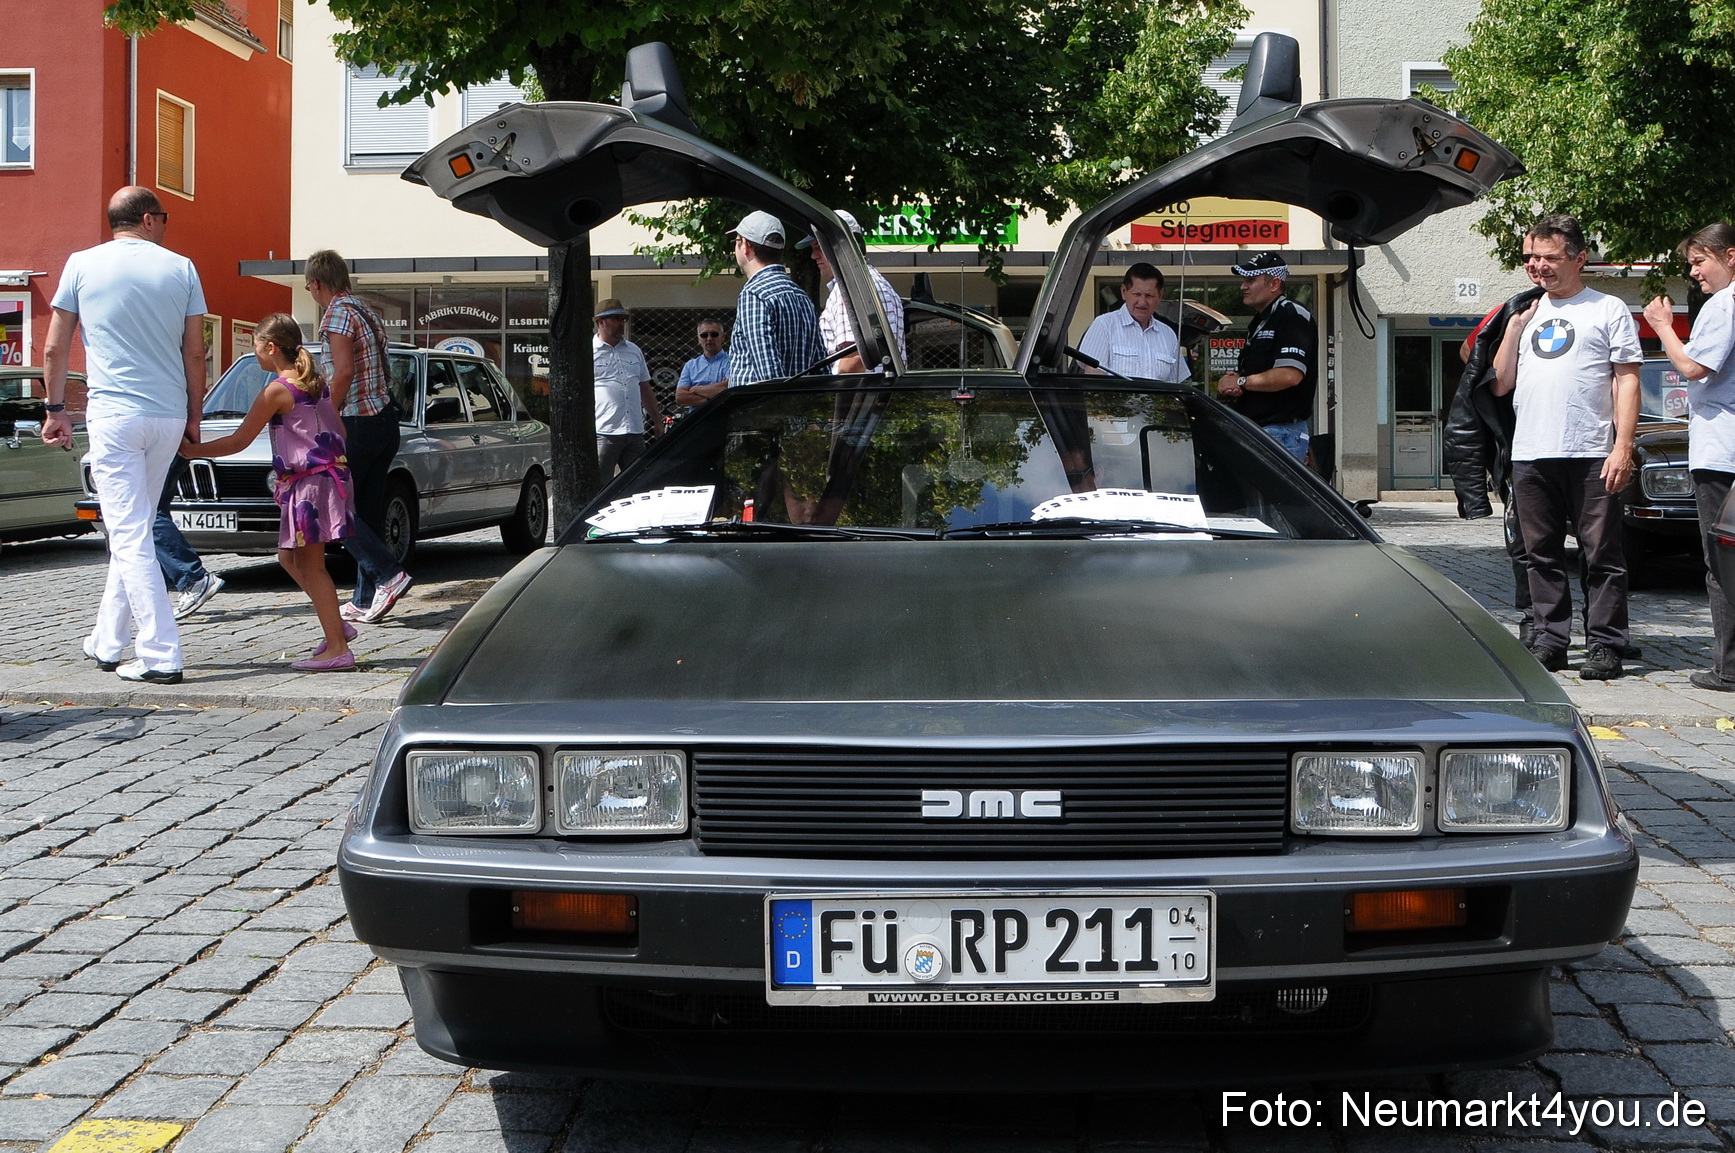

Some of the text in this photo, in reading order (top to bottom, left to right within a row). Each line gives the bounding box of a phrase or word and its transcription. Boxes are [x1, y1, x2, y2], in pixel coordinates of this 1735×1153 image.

[1160, 219, 1283, 243] Stegmeier
[1458, 283, 1477, 297] 28
[382, 319, 407, 327] LLER
[418, 306, 499, 326] FABRIKVERKAUF
[1536, 318, 1574, 333] BMW
[513, 344, 549, 353] Kräute
[1210, 338, 1245, 349] DIGIT
[528, 355, 550, 365] Gew
[1210, 348, 1240, 358] PASS
[1666, 397, 1688, 411] SSV
[182, 513, 236, 529] N 401H
[820, 907, 1158, 974] FÜ RP 211
[786, 950, 801, 969] D
[1171, 952, 1195, 970] 10
[873, 991, 1116, 1002] WWW.DELOREANCLUB.DE
